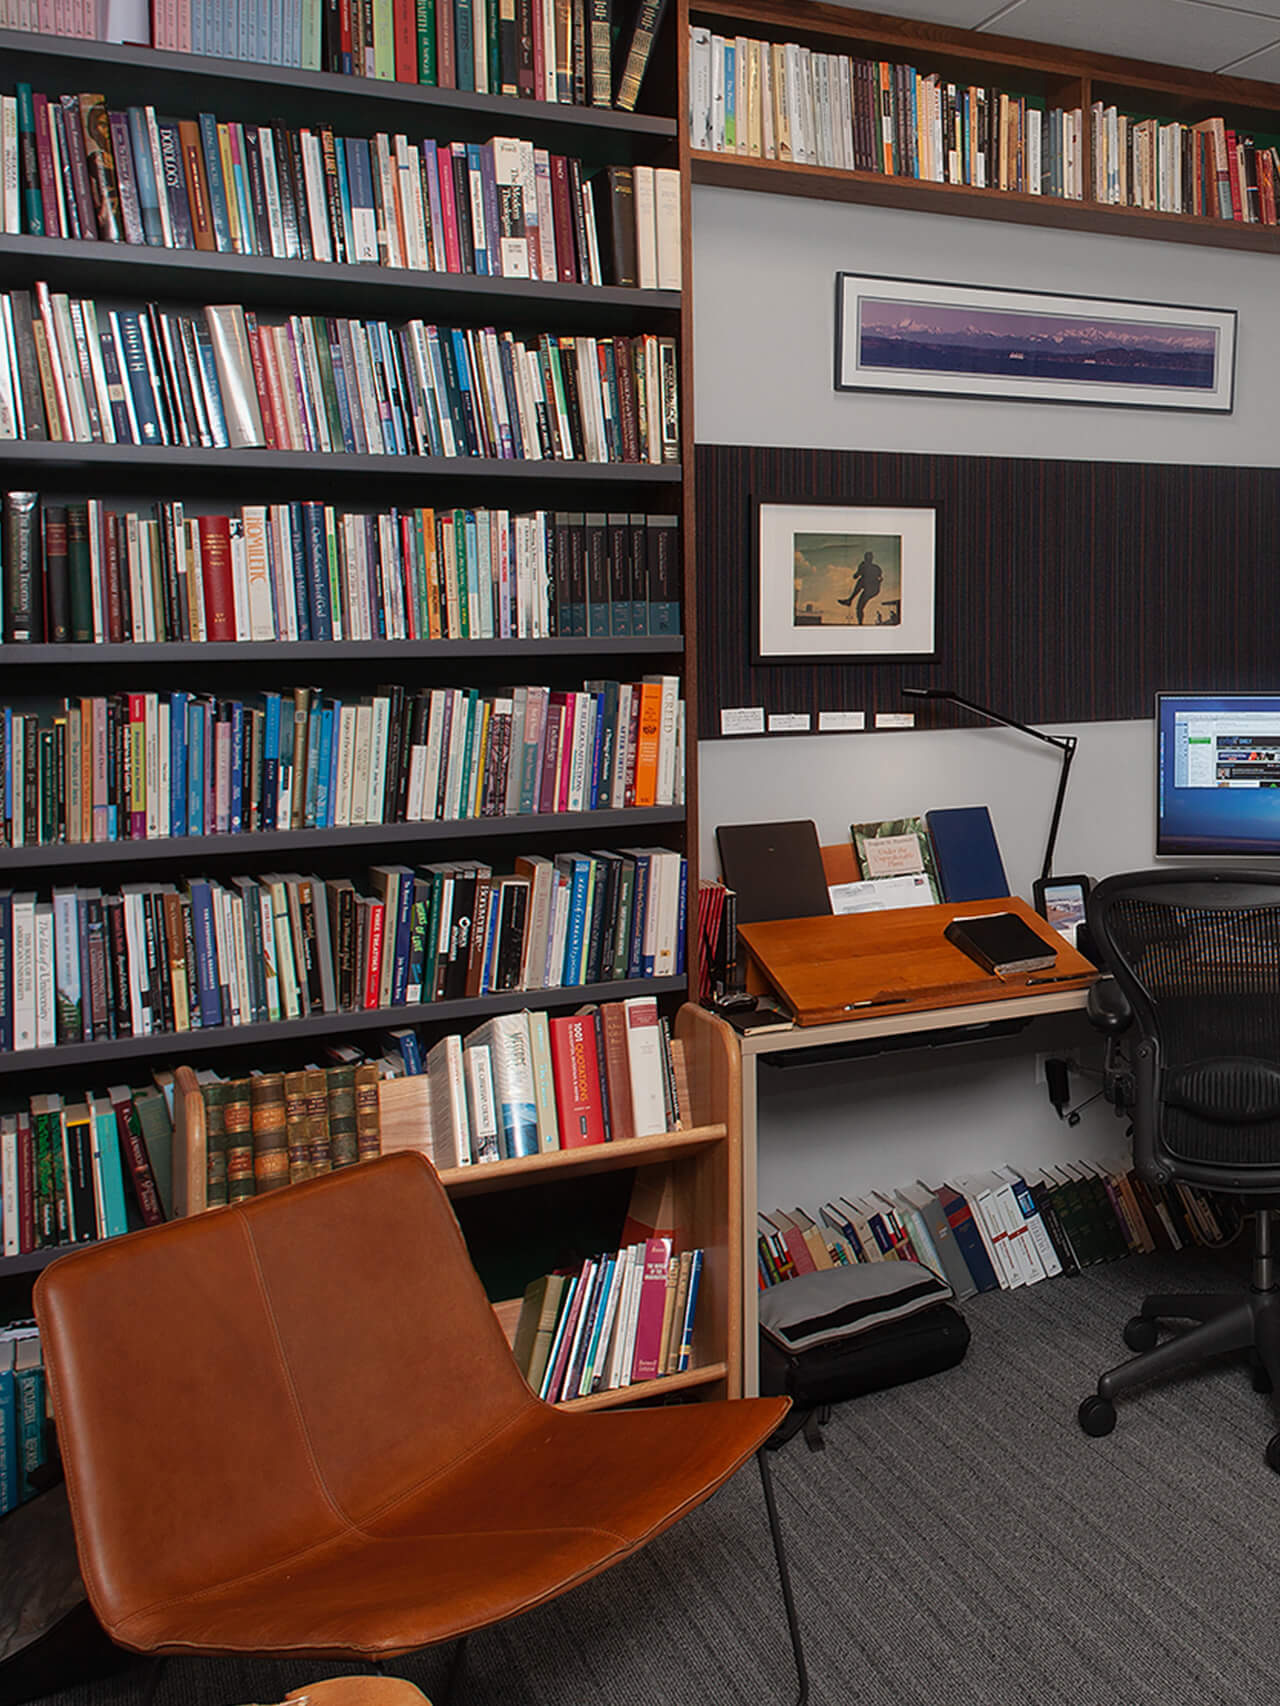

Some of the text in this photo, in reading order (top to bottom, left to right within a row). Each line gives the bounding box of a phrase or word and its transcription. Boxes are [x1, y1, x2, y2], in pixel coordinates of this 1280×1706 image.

[501, 187, 513, 237] Theologians
[510, 168, 522, 219] The Modern
[245, 517, 266, 584] HOMILETIC
[39, 921, 47, 936] The
[39, 937, 48, 955] Idea
[38, 957, 48, 966] of
[38, 973, 51, 1020] University
[574, 1022, 588, 1103] 1001 QUOTATIONS
